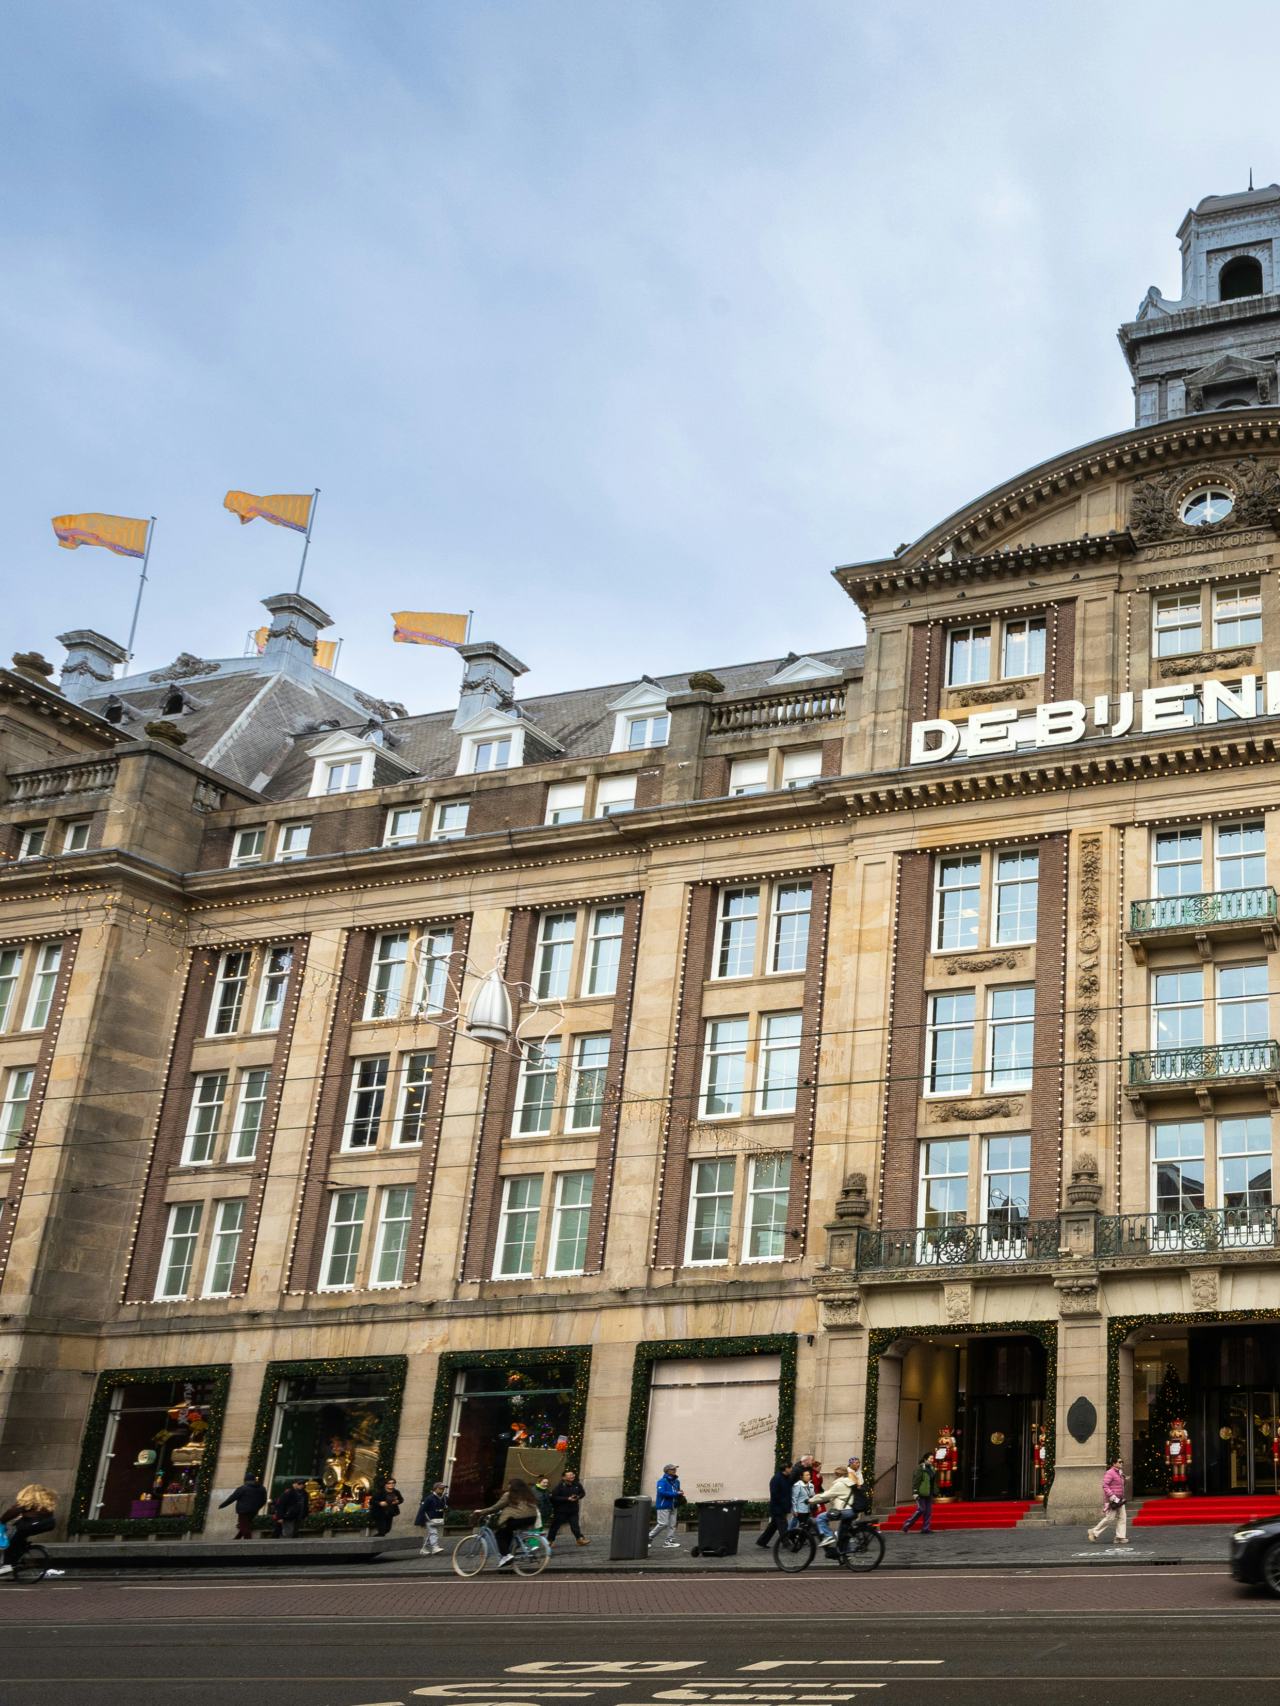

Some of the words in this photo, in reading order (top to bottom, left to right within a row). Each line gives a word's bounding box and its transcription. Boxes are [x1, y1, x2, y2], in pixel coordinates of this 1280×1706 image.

[1144, 545, 1167, 561] DE
[909, 708, 1018, 765] DE
[349, 1660, 708, 1706] BU
